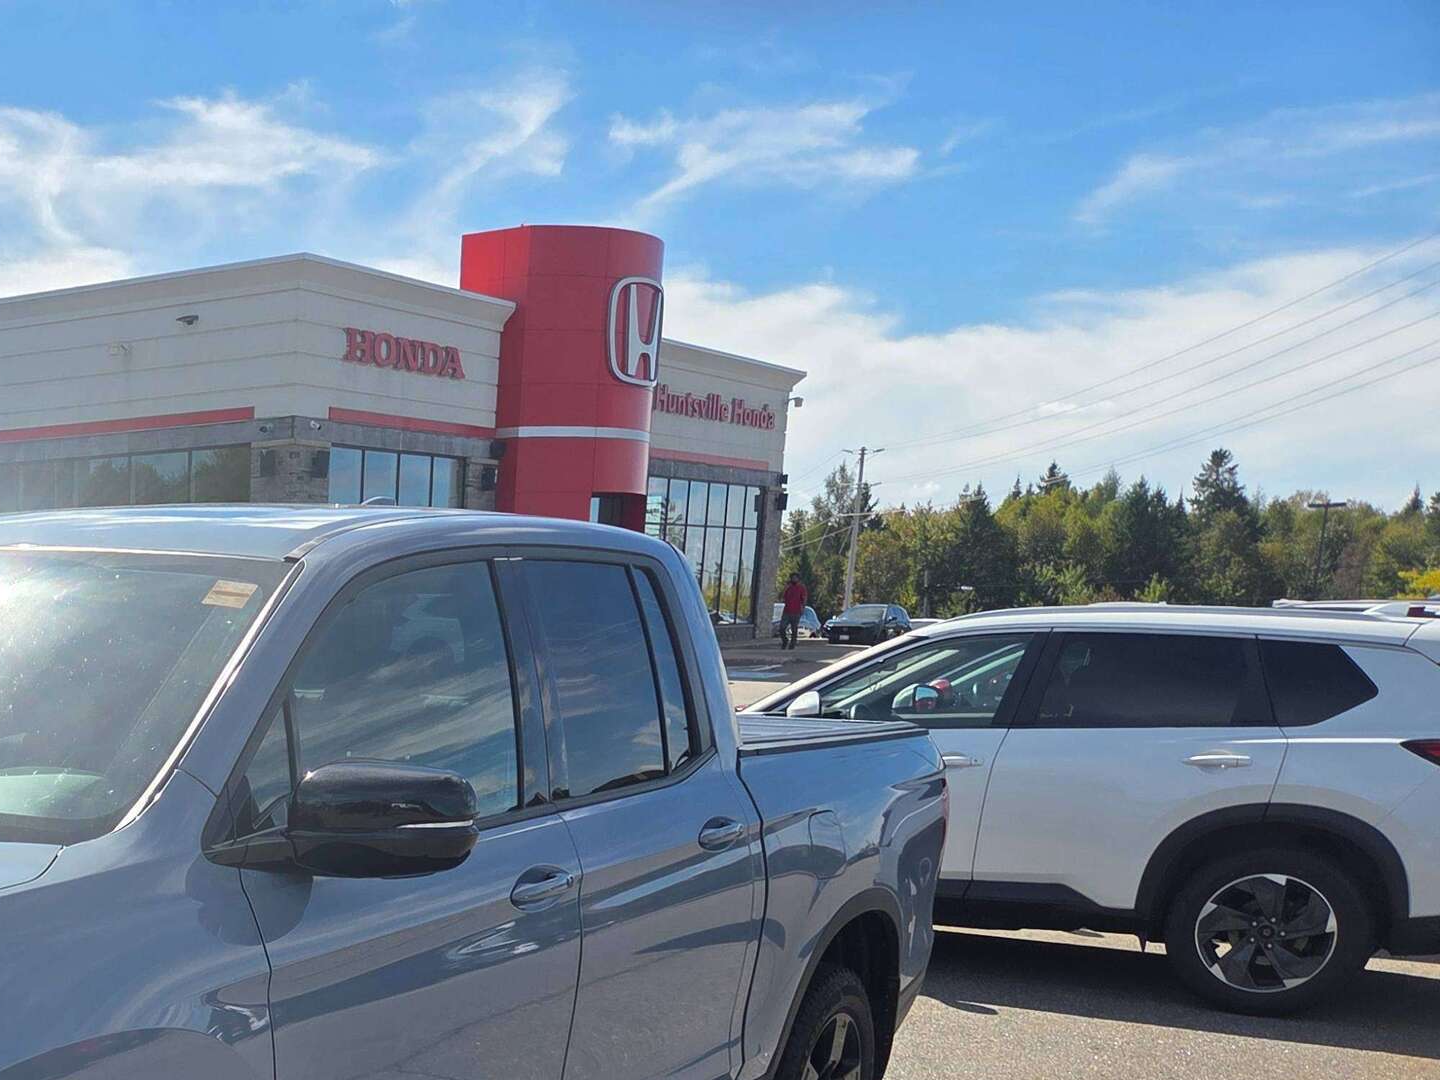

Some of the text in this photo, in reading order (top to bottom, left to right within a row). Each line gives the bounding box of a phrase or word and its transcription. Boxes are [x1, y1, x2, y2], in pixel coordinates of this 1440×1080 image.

[343, 327, 465, 379] HONDA
[653, 383, 776, 430] Huntsville Honda
